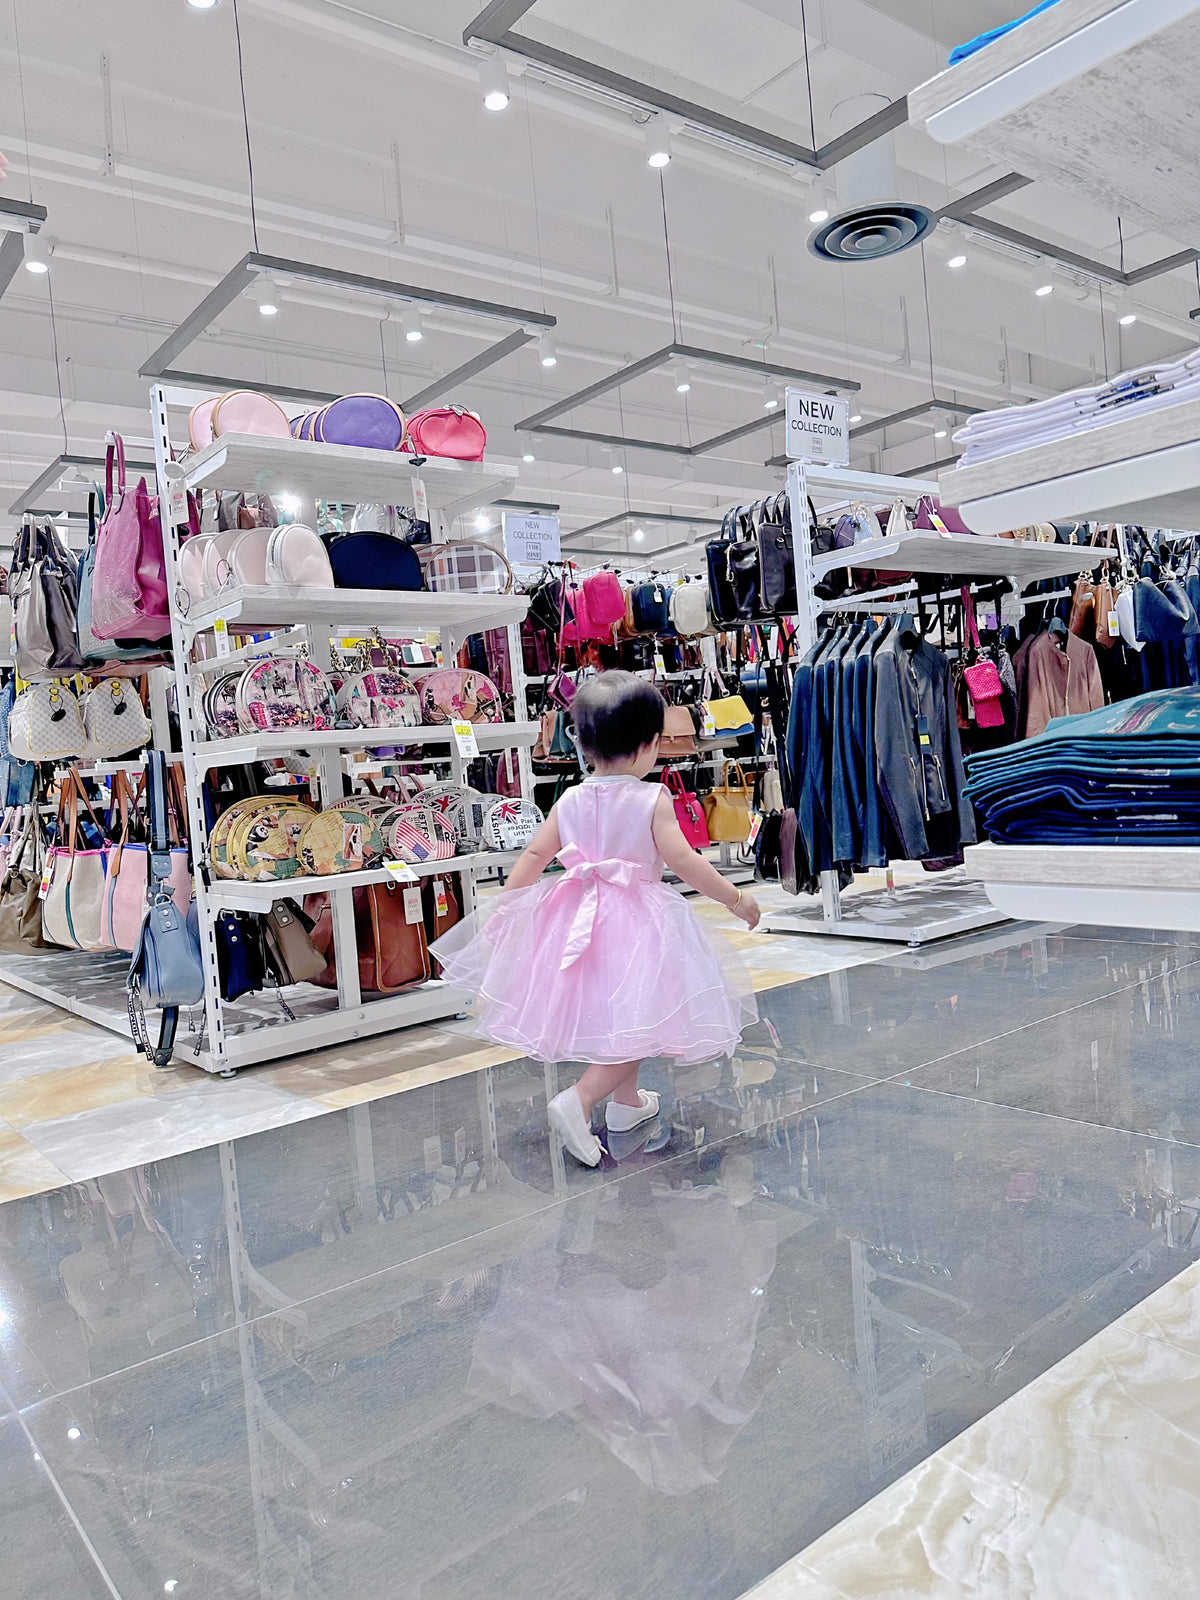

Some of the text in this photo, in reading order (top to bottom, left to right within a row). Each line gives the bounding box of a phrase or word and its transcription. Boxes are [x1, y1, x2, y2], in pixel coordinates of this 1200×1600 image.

[799, 399, 835, 421] NEW
[791, 419, 842, 437] COLLECTION
[525, 521, 540, 529] NEW
[513, 531, 553, 541] COLLECTION
